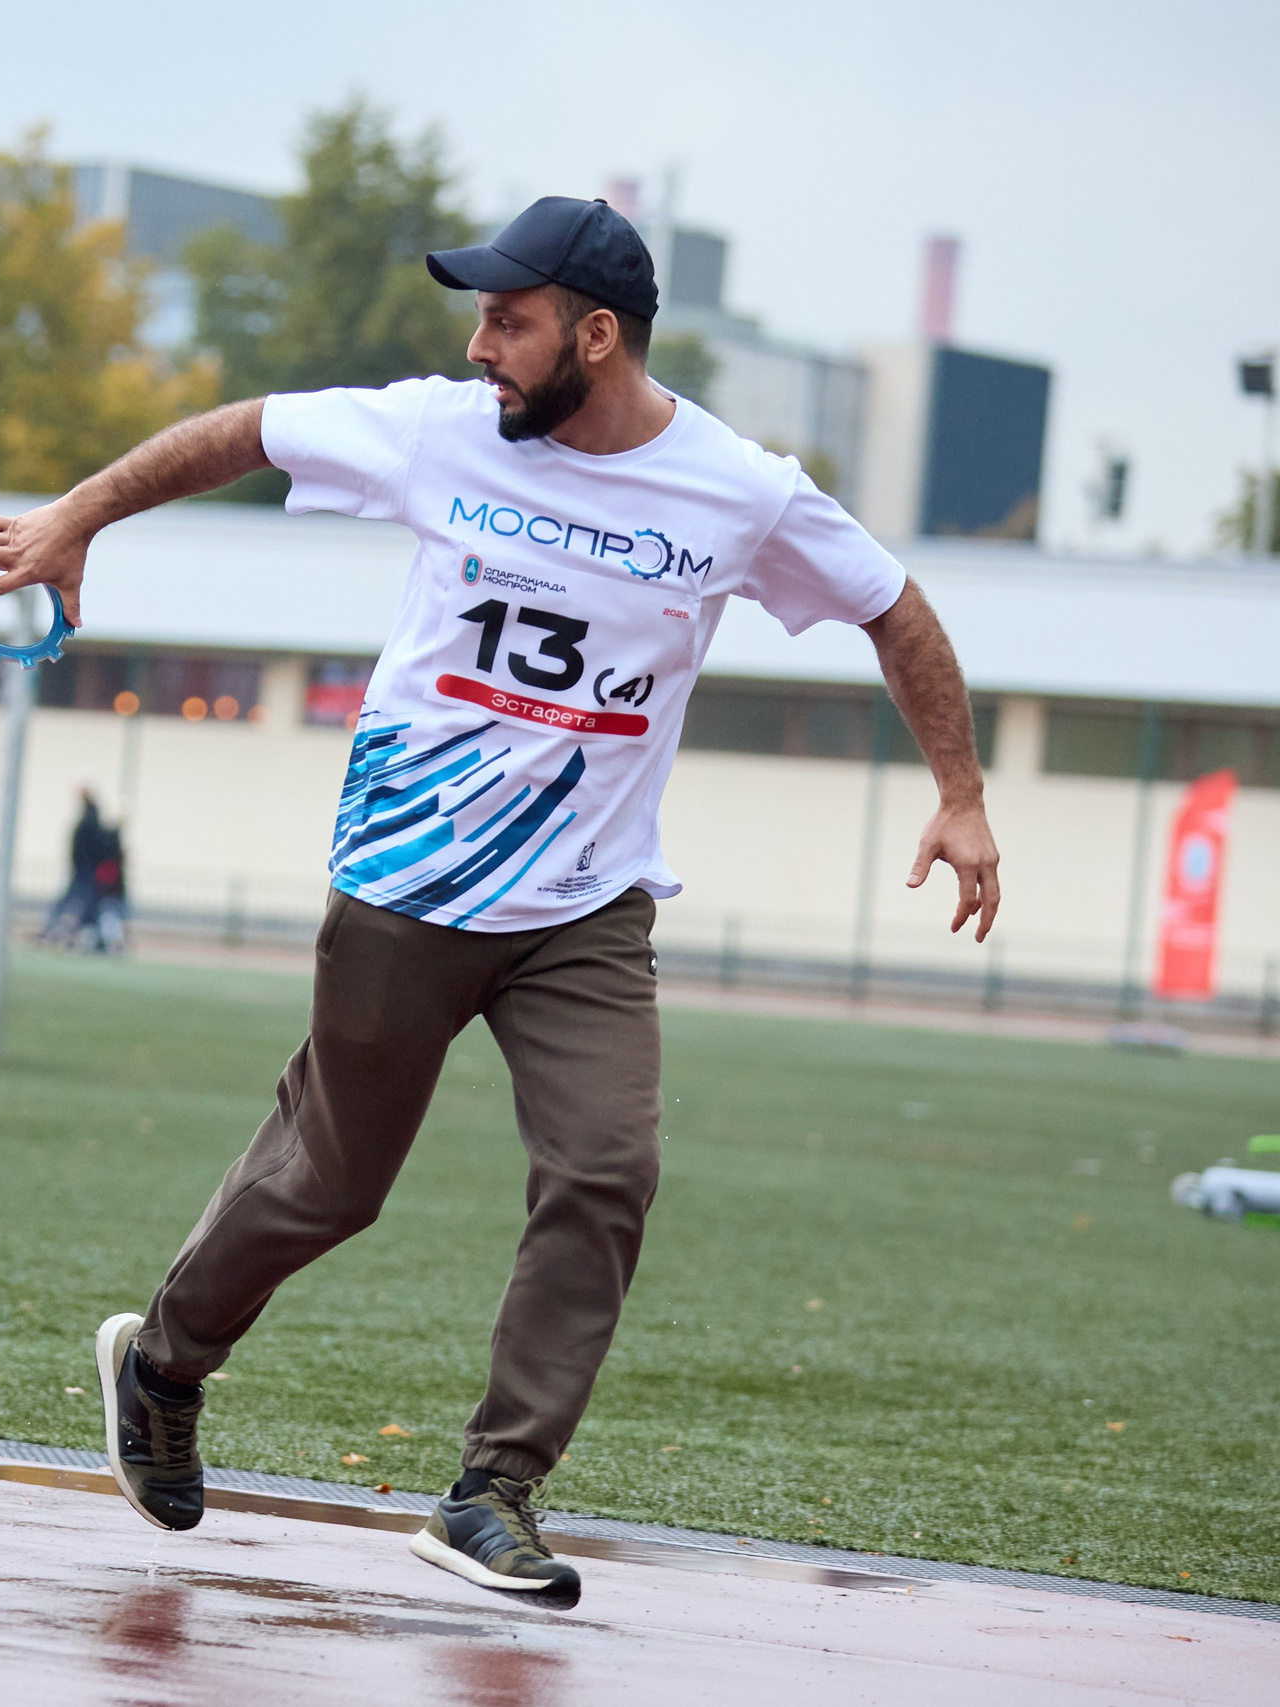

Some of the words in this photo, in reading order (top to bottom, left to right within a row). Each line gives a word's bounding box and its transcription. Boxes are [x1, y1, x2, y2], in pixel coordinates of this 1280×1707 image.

[448, 496, 714, 585] МОСПРОМ
[482, 574, 538, 595] МОСПРОМ
[483, 567, 567, 594] СПАРТАКИАДА
[662, 607, 690, 620] 2025
[456, 598, 590, 692] 13
[592, 666, 655, 708] (4)
[491, 692, 597, 729] Эстафета
